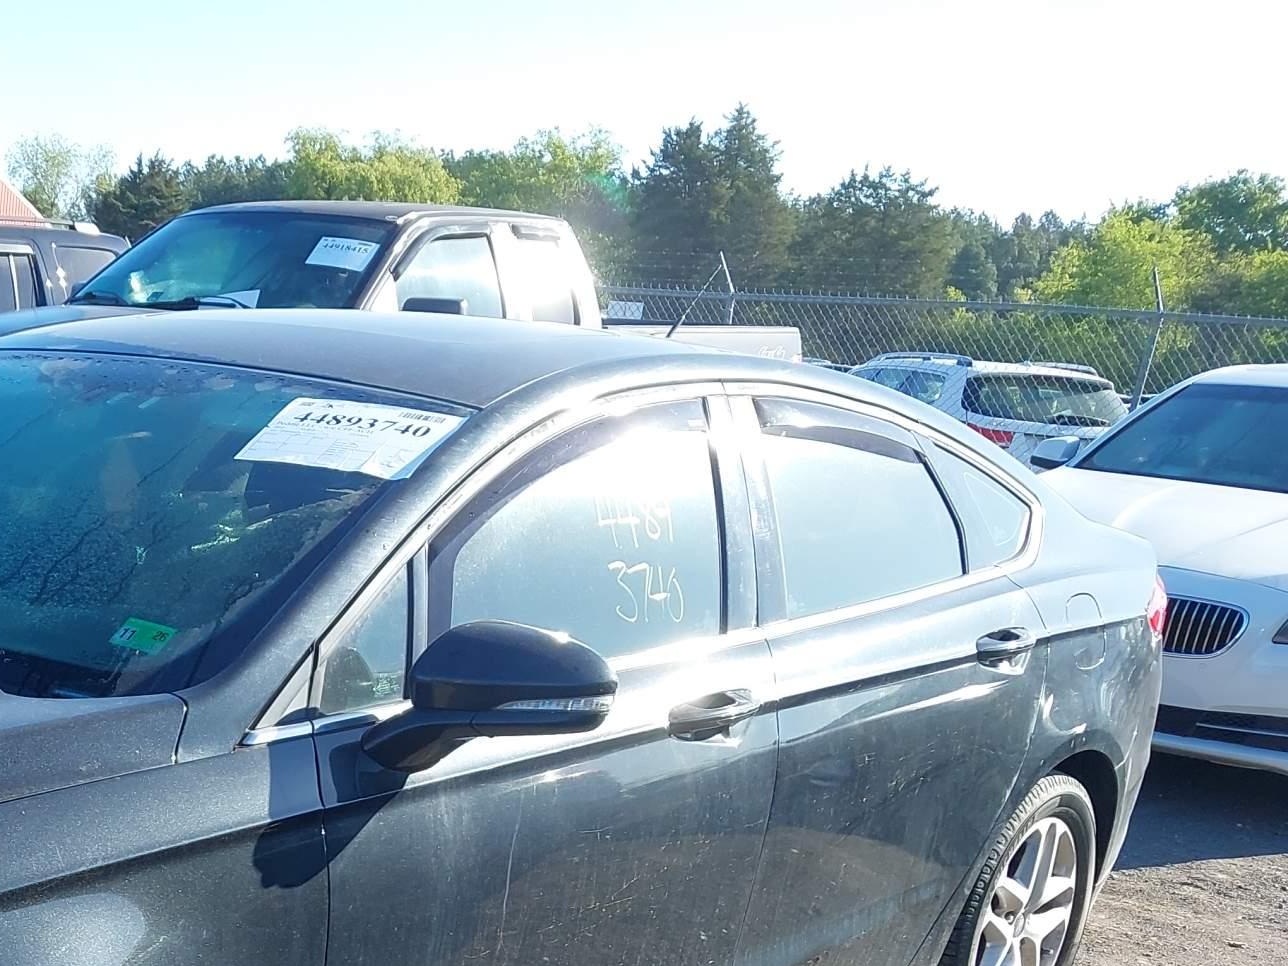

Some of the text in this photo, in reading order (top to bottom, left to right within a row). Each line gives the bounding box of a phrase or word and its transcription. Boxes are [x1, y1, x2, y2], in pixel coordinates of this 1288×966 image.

[292, 411, 432, 439] 44893740
[607, 560, 685, 623] 3740
[152, 630, 169, 641] 26
